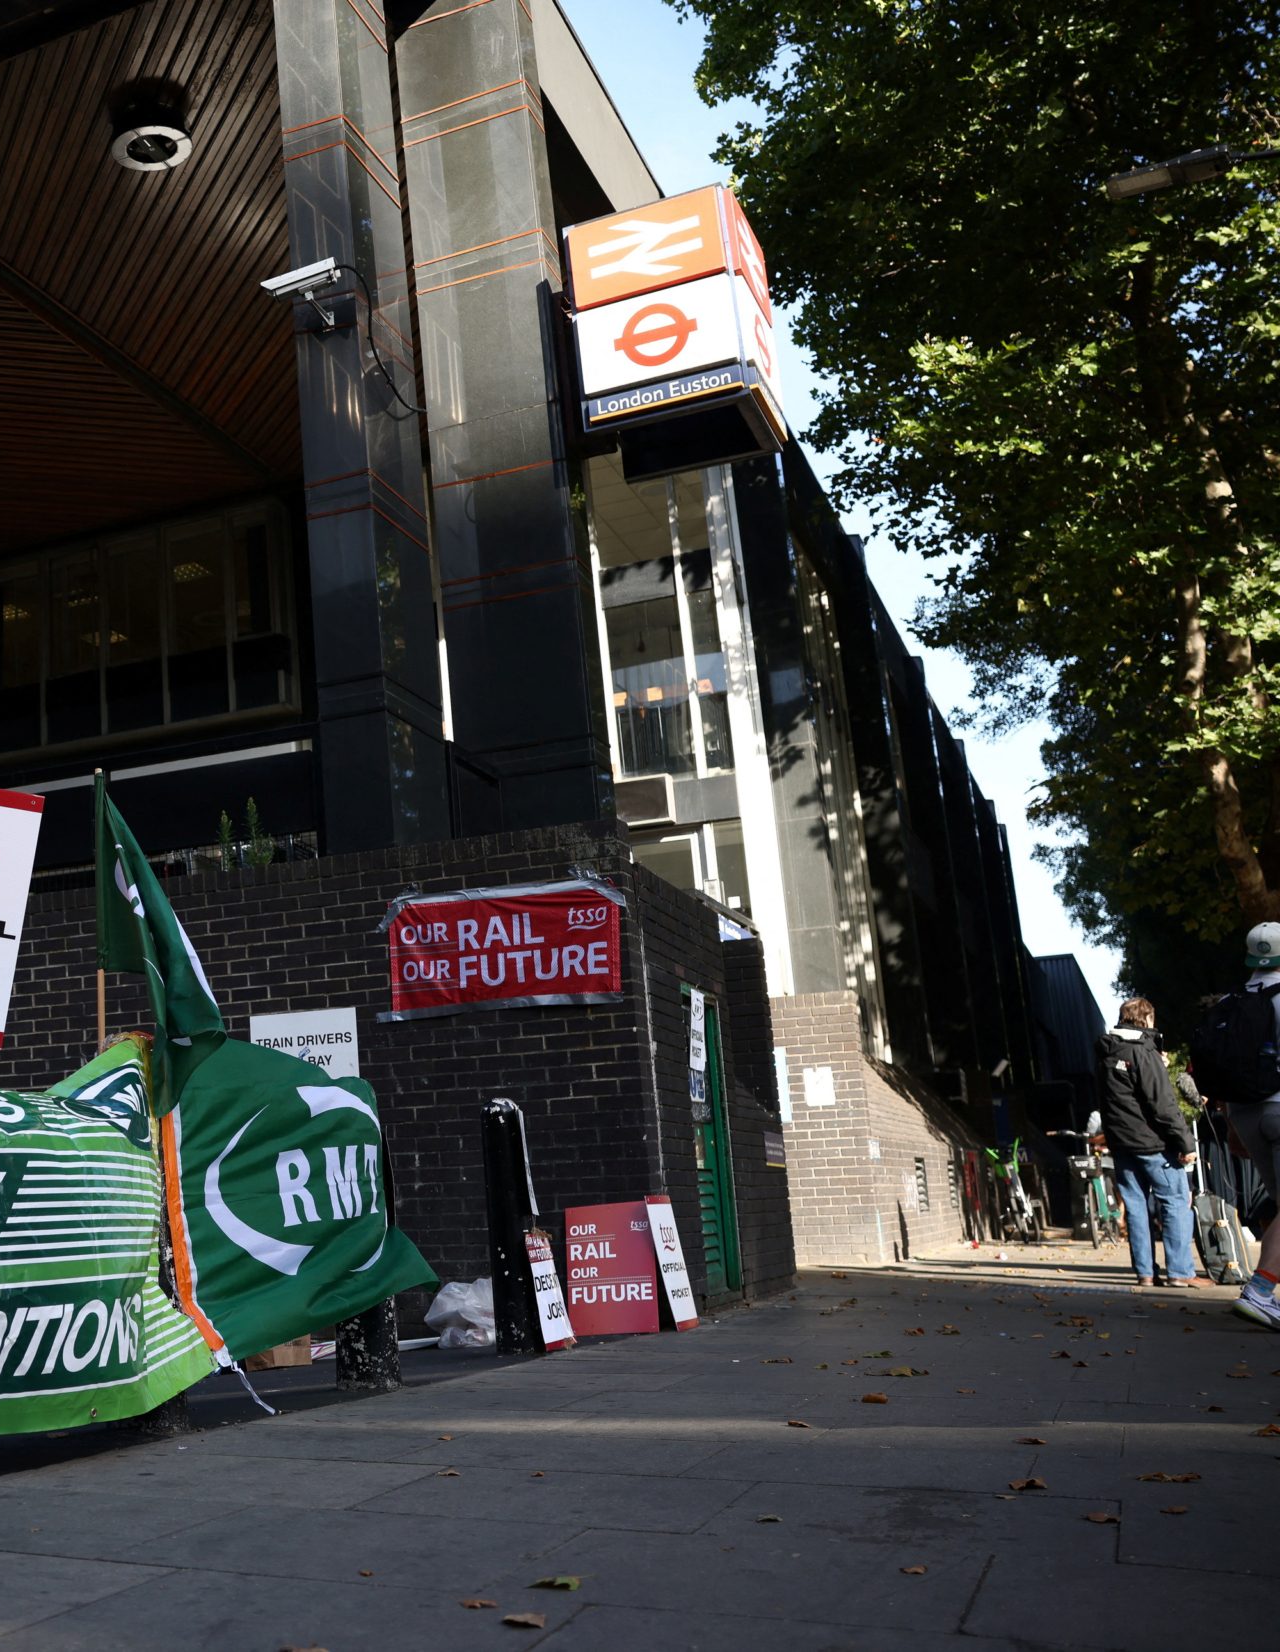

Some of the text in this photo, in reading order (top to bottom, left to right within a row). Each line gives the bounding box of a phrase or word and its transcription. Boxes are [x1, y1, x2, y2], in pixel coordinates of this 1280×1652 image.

[597, 386, 664, 415] London
[669, 371, 732, 397] Euston
[568, 906, 607, 926] tssa
[400, 912, 544, 951] OUR RAIL
[403, 941, 609, 989] OUR FUTURE
[256, 1032, 352, 1048] TRAIN DRIVERS
[308, 1055, 332, 1067] BAY
[276, 1143, 380, 1227] RMT
[570, 1224, 596, 1236] OUR
[631, 1221, 648, 1230] tssa
[660, 1223, 675, 1243] tssa
[570, 1241, 617, 1261] RAIL
[571, 1267, 598, 1279] OUR
[662, 1261, 686, 1274] OFFICIAL
[571, 1283, 653, 1304] FUTURE
[671, 1287, 690, 1300] PICKET
